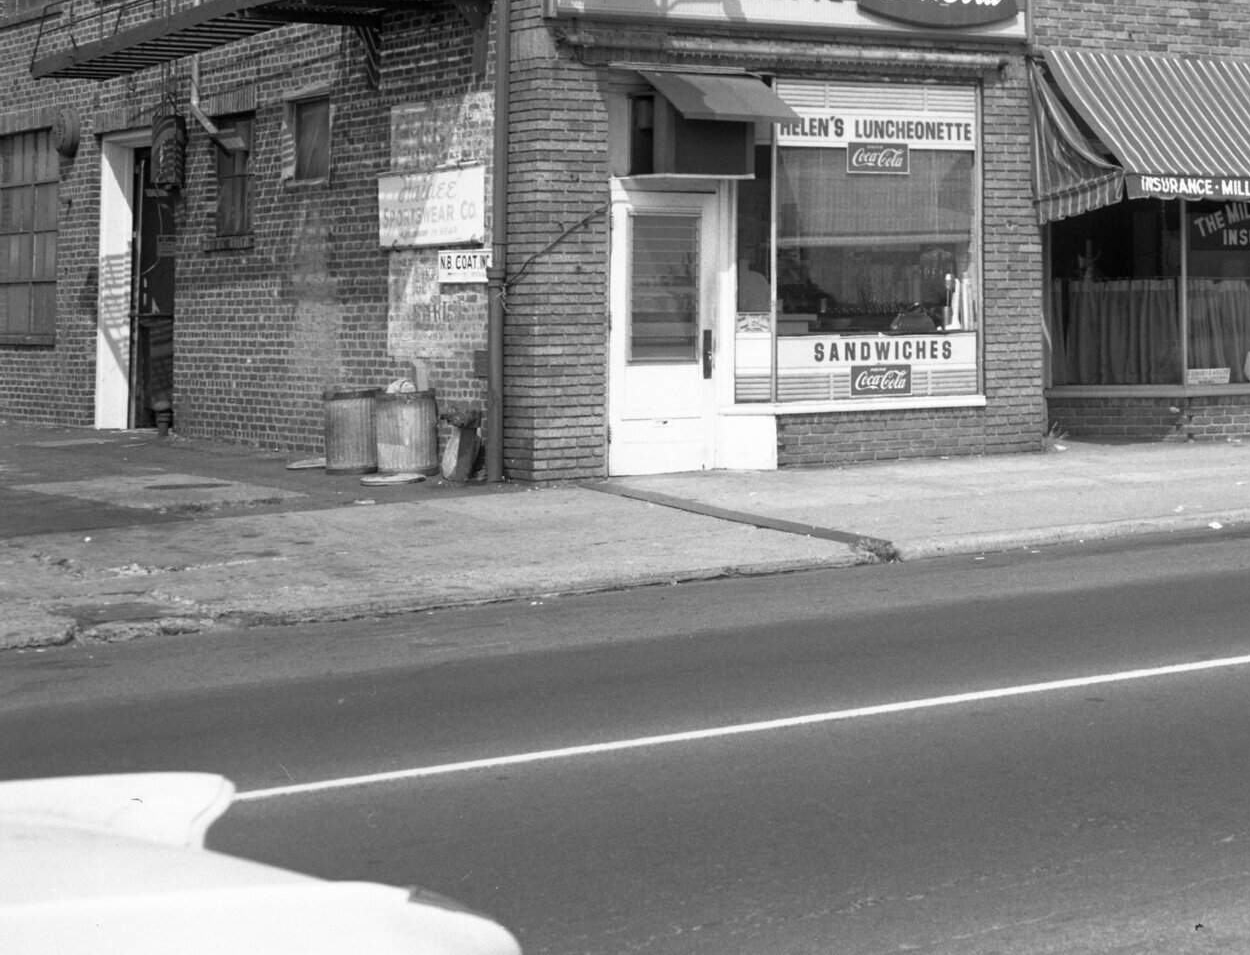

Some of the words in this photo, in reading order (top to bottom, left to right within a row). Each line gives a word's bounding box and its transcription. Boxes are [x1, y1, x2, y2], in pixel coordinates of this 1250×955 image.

[779, 115, 844, 138] HELEN'S
[854, 119, 972, 142] LUNCHEONETTE
[852, 148, 904, 167] Coca-Cola
[1141, 175, 1214, 195] INSURANCE
[382, 205, 455, 229] SPORTSWEAR
[1193, 210, 1225, 237] THE
[813, 340, 953, 362] SANDWICHES
[855, 369, 908, 391] Coca-Cola
